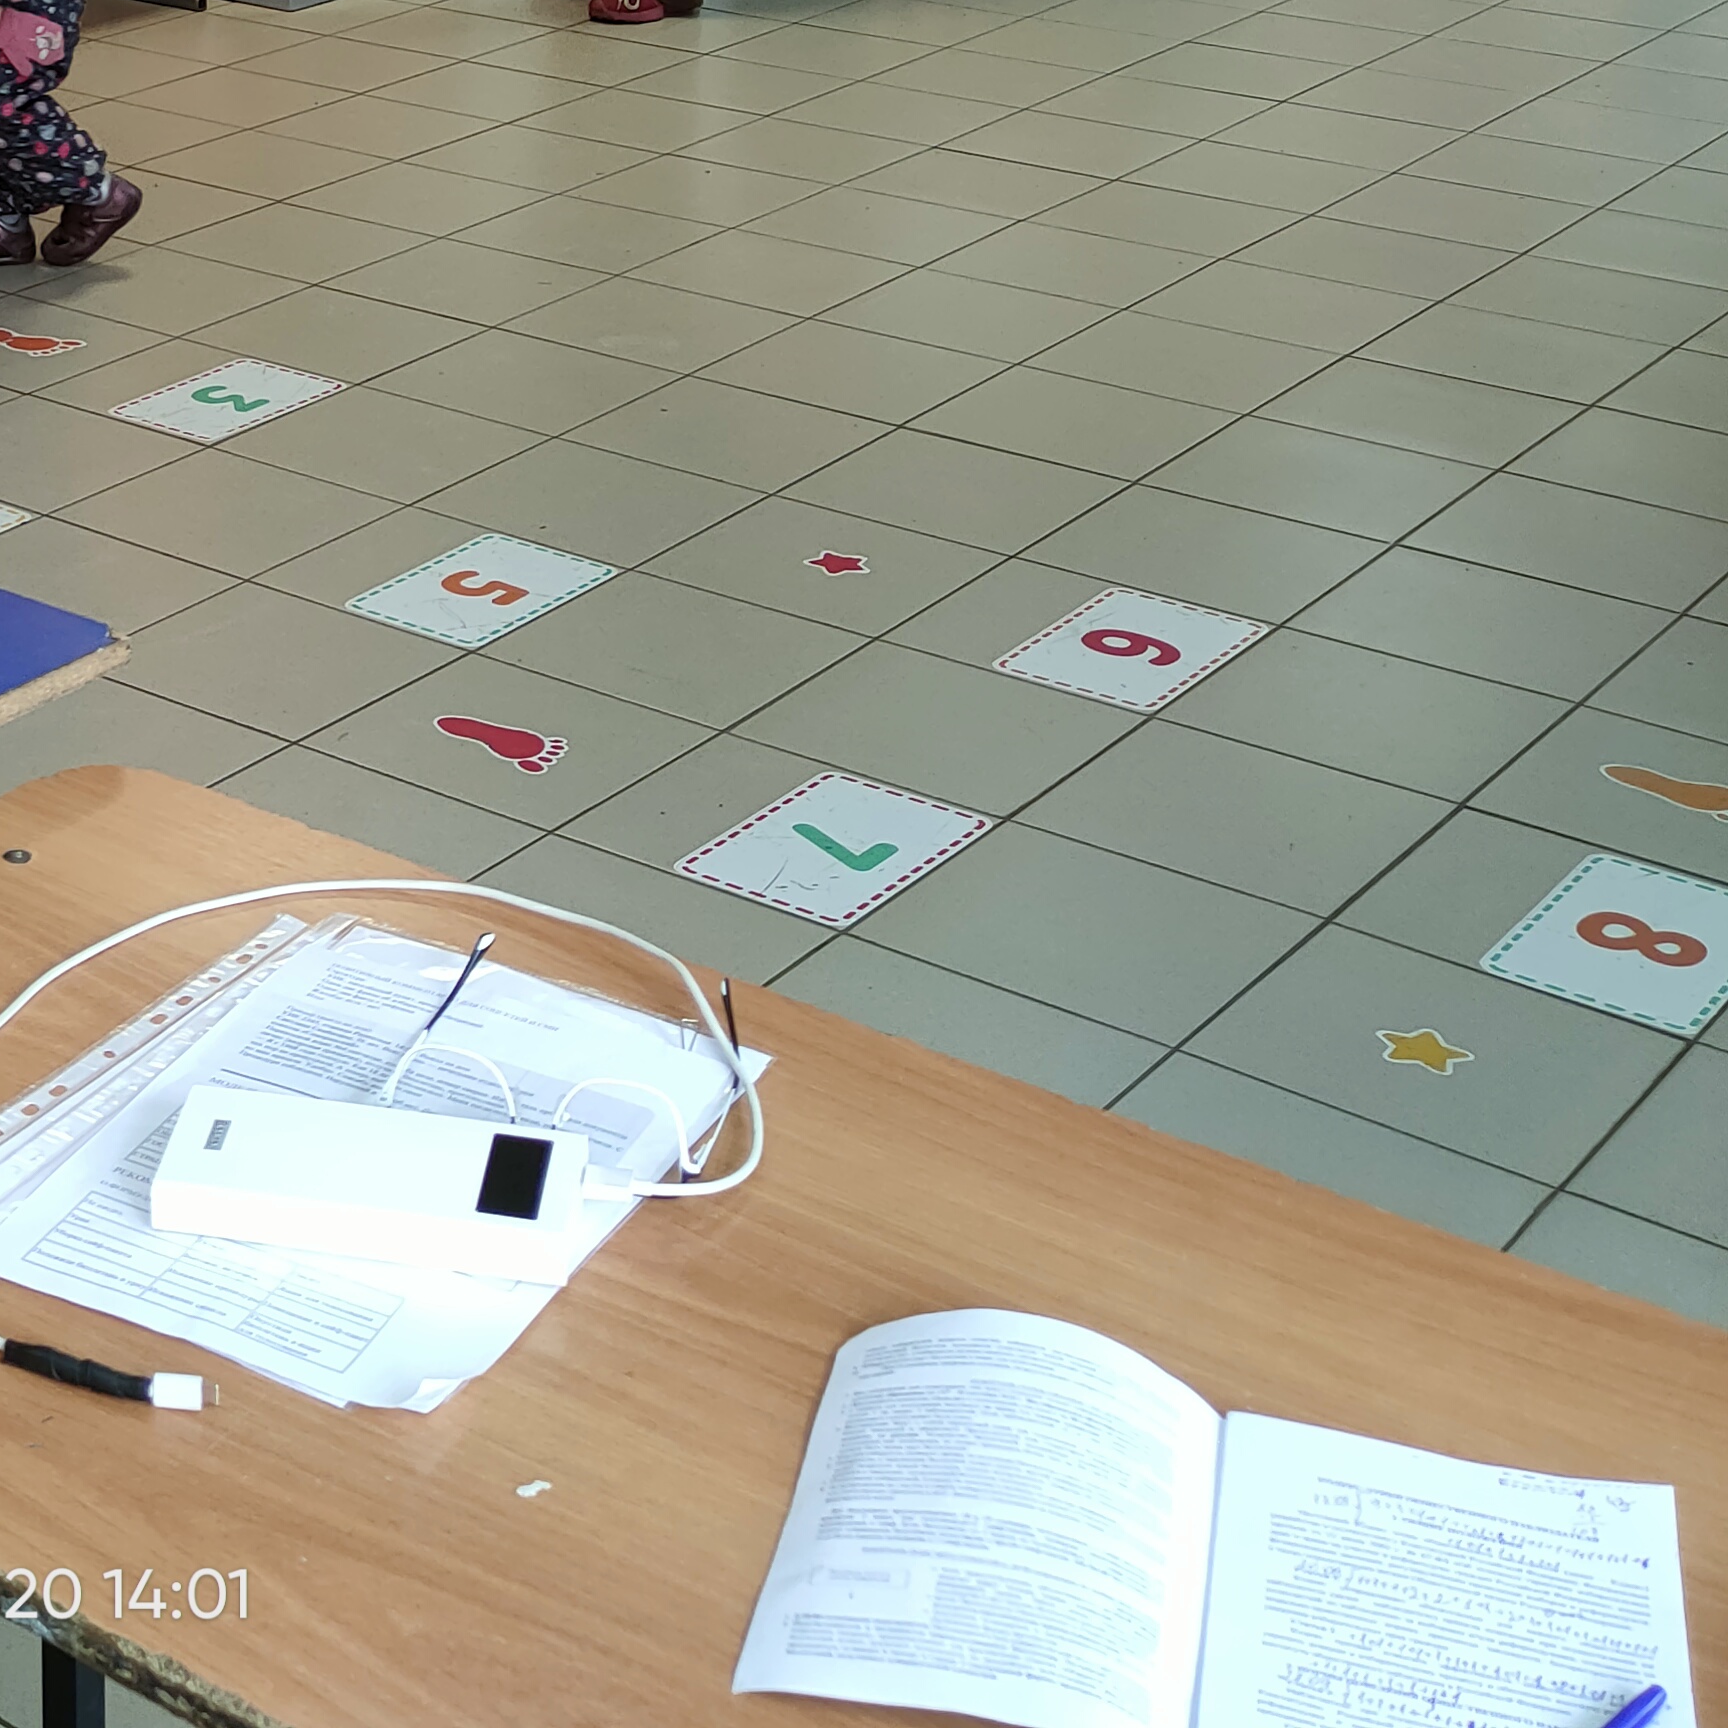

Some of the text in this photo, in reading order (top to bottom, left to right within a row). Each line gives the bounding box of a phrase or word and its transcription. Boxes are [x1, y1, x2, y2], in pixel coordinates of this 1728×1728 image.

[191, 384, 270, 414] 3
[440, 570, 529, 606] 5
[791, 822, 899, 872] 7
[1576, 912, 1707, 967] 8
